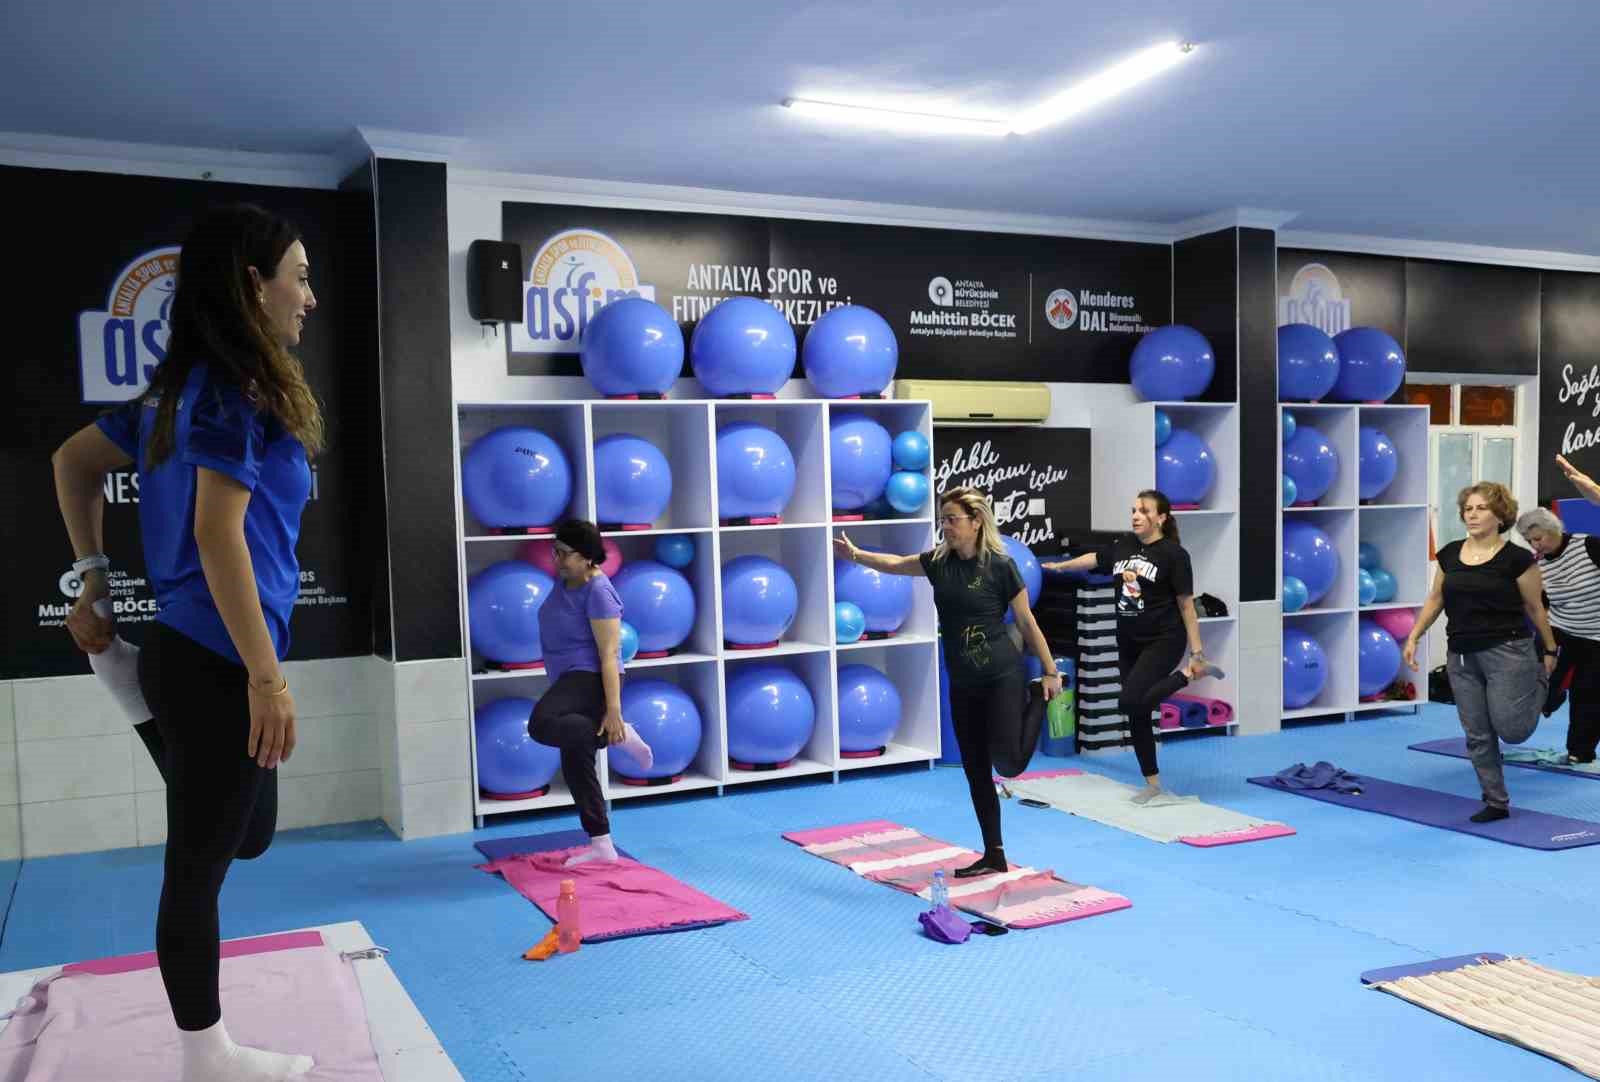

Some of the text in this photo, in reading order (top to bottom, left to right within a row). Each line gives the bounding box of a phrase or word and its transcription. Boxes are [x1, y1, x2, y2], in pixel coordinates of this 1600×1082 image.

[687, 263, 838, 296] ANTALYA SPOR ve
[954, 280, 984, 288] ANTALYA
[1079, 289, 1135, 308] Menderes
[910, 309, 1016, 328] Muhittin BÖCEK
[1079, 310, 1108, 332] DAL
[910, 327, 934, 337] Antalya
[932, 440, 1000, 494] ağlıklı
[1029, 465, 1068, 491] için
[112, 597, 161, 614] BÖCE
